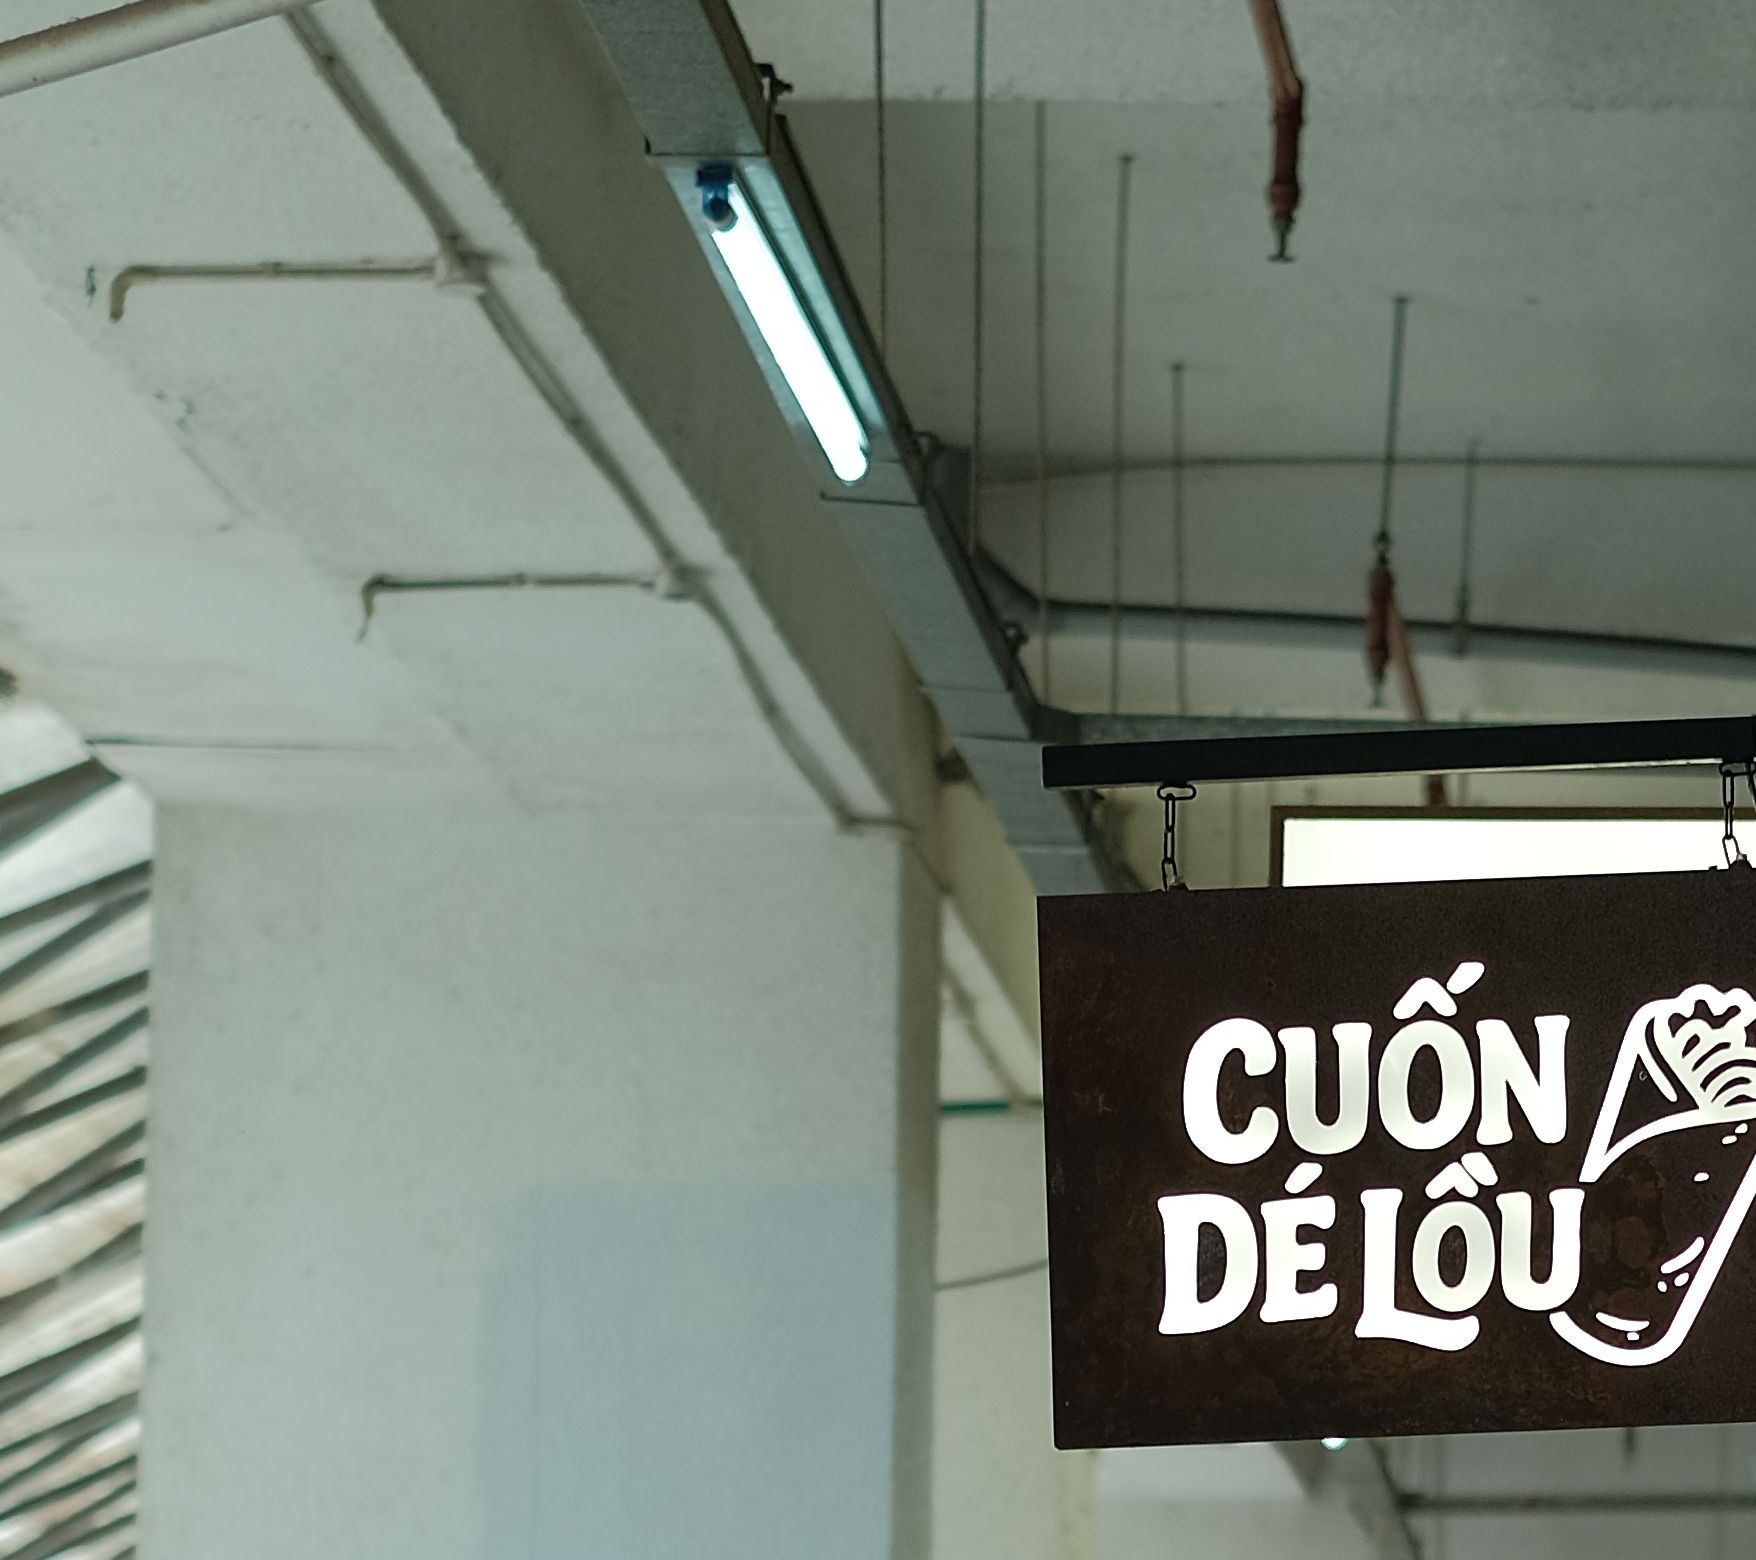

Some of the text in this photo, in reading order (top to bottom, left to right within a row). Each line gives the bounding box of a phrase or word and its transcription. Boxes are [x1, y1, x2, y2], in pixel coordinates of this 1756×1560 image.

[1183, 961, 1571, 1165] CUỐN
[1157, 1152, 1585, 1351] DÉ LỒU
